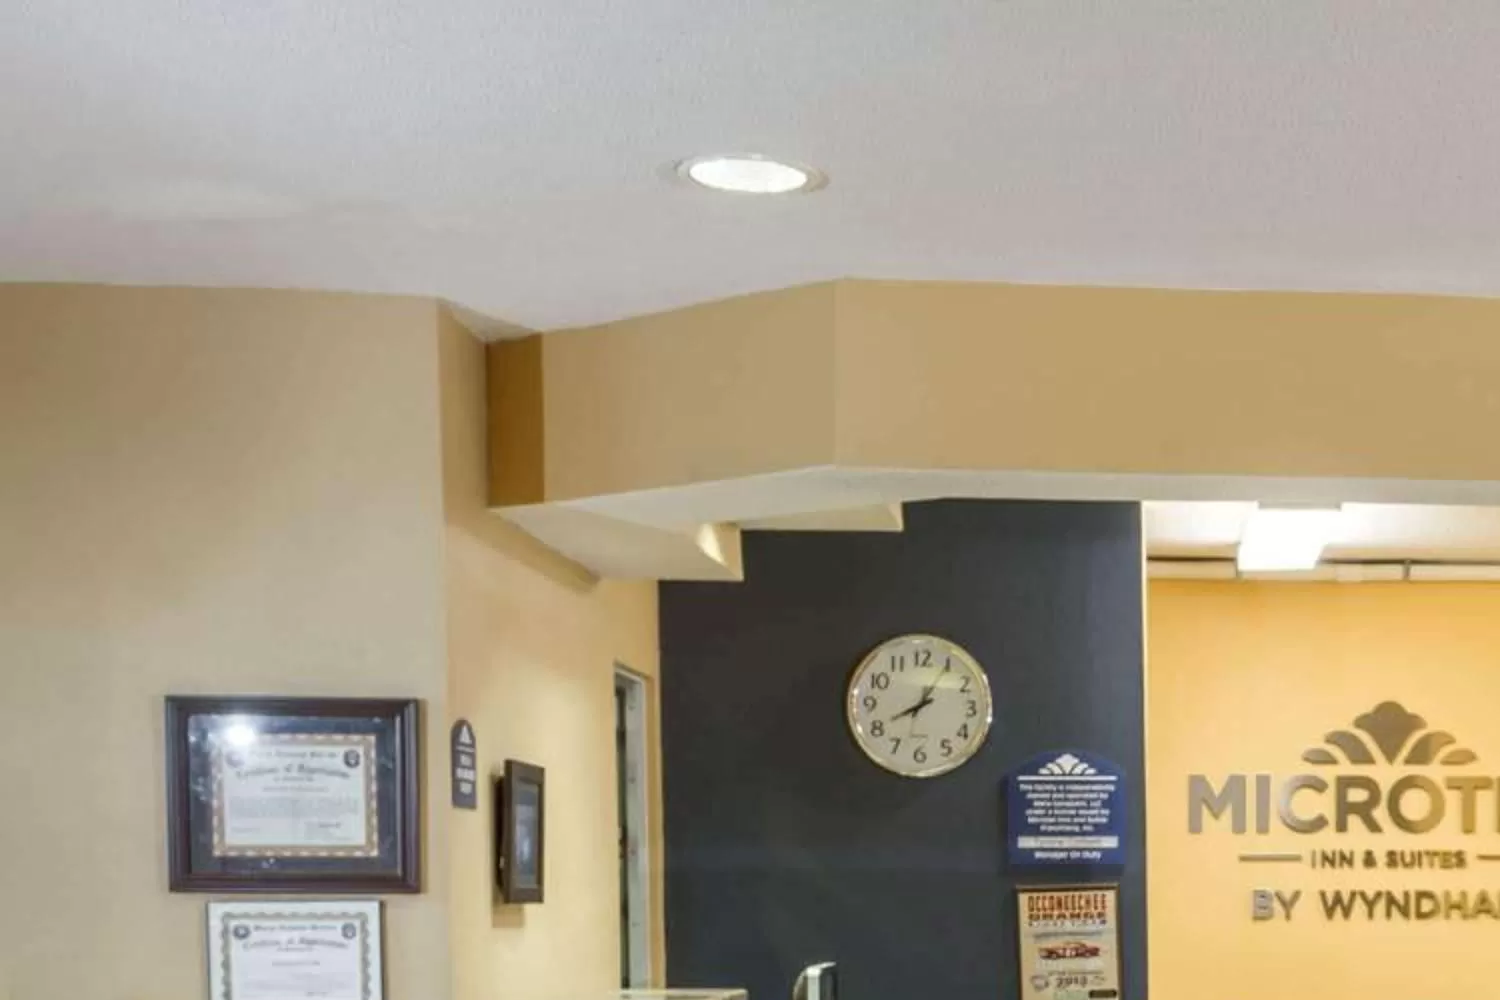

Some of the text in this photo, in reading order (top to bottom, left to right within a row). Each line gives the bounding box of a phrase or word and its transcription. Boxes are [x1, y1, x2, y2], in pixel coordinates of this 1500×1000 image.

[891, 655, 904, 672] 11
[914, 649, 932, 667] 12
[871, 672, 890, 689] 10
[959, 675, 971, 693] 2
[863, 696, 877, 712] 9
[965, 700, 977, 717] 3
[870, 719, 884, 737] 8
[956, 724, 968, 740] 4
[889, 737, 901, 754] 7
[913, 744, 927, 763] 6
[940, 739, 952, 757] 5
[1311, 850, 1467, 869] INN & SUITES
[1252, 889, 1301, 921] BY
